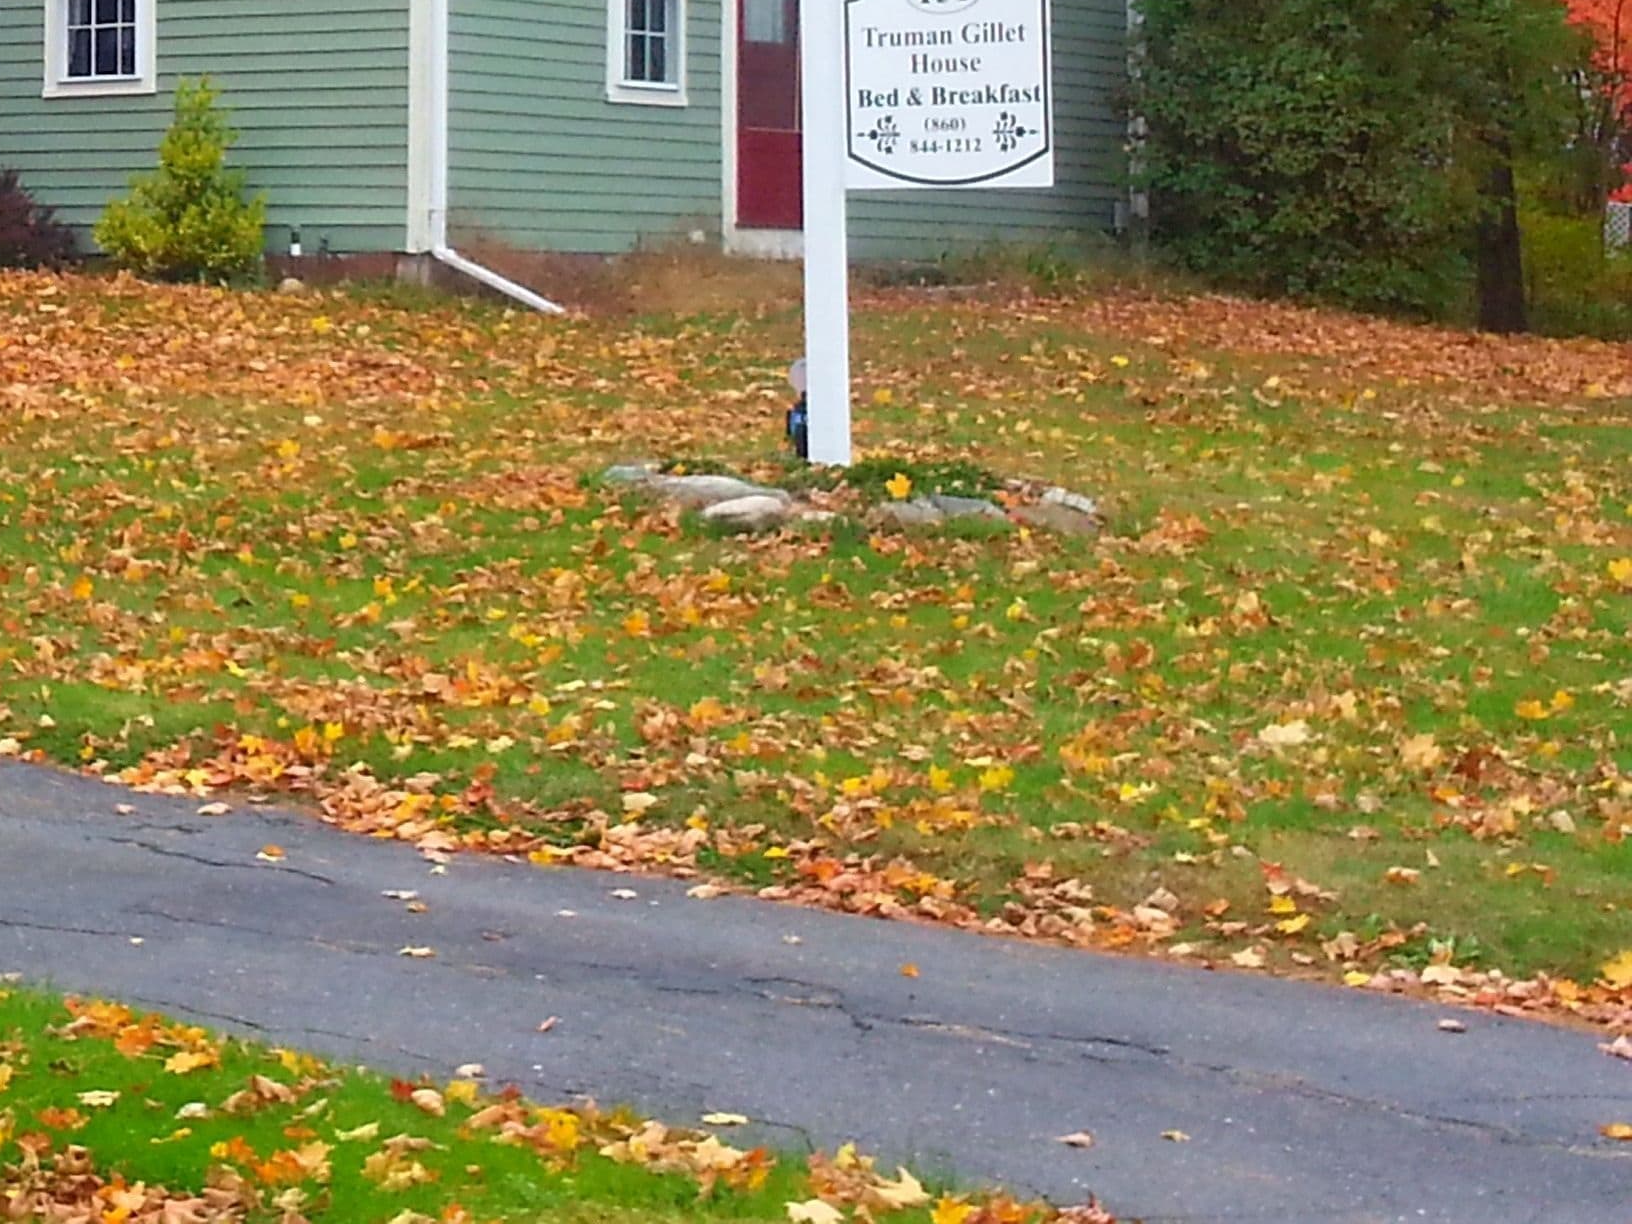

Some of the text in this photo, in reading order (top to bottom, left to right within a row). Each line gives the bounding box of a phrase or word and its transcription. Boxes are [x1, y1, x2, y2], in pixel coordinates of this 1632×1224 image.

[863, 22, 1025, 47] Truman Gillet
[911, 53, 981, 74] House
[858, 84, 1041, 108] Bed & Breakfast
[923, 116, 967, 132] (860)
[910, 138, 982, 152] 844-1212
